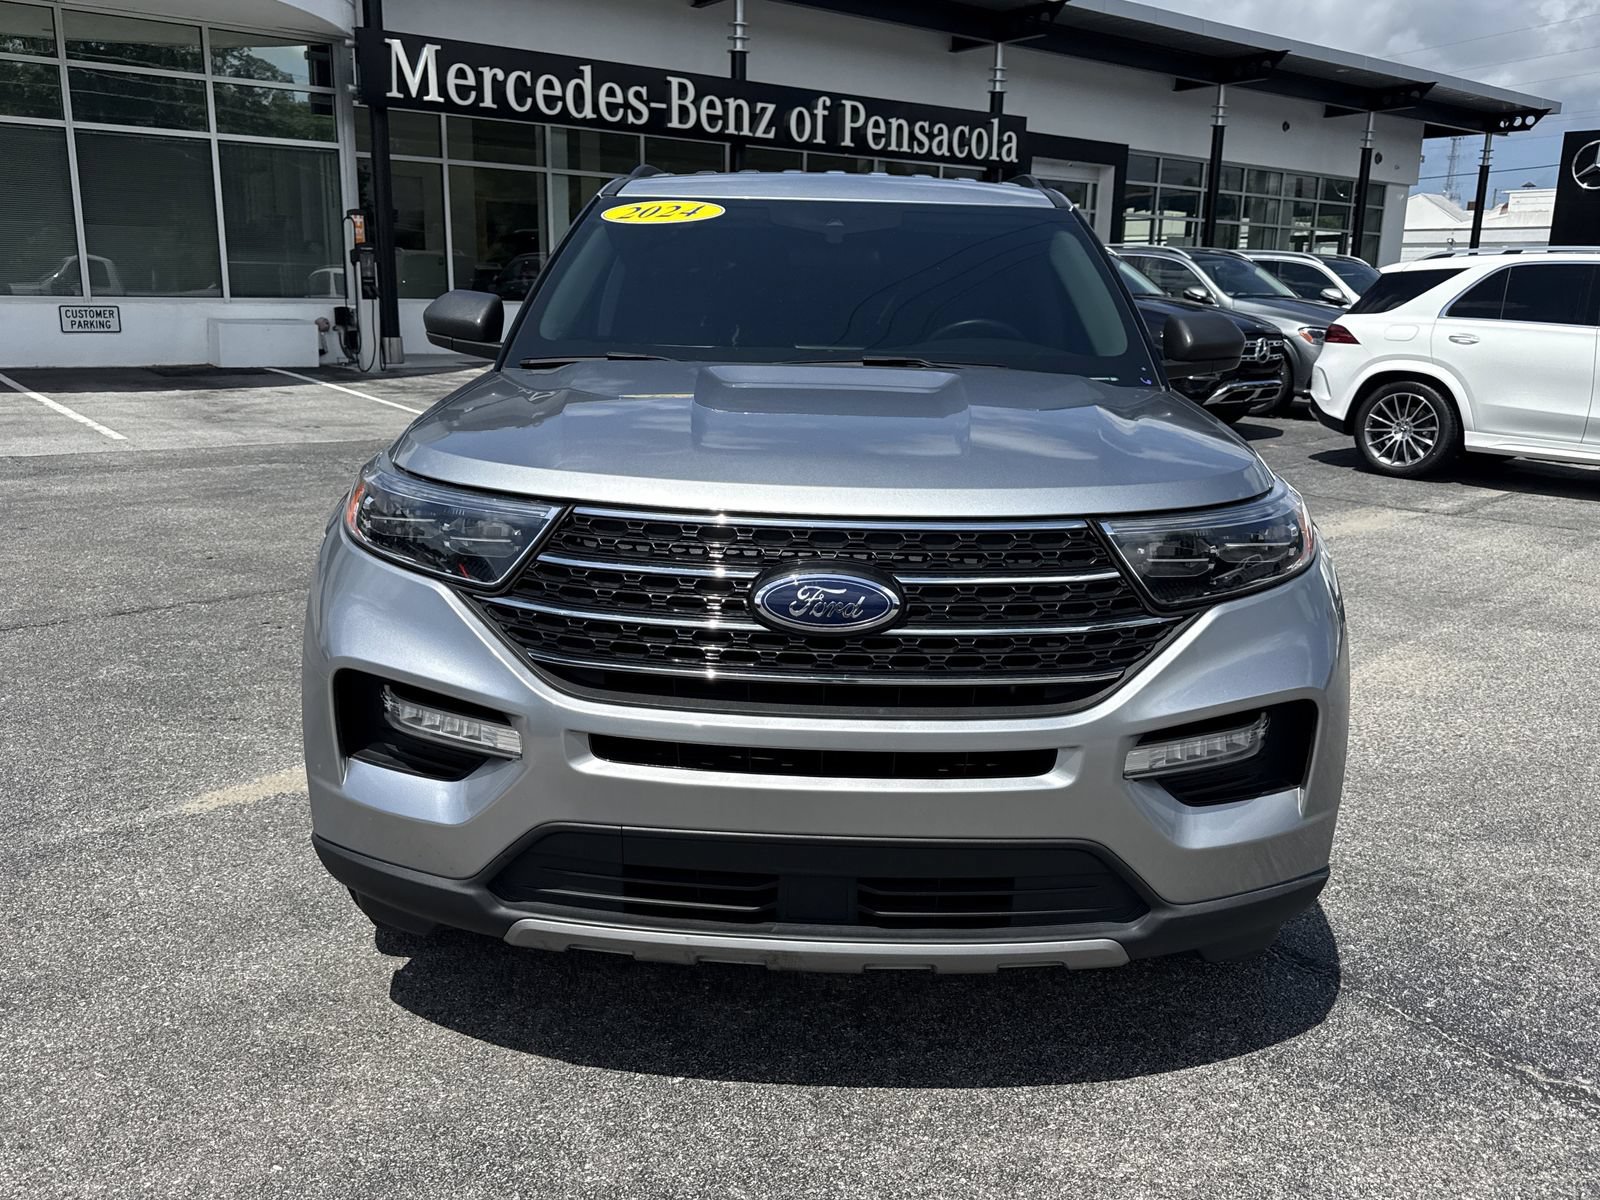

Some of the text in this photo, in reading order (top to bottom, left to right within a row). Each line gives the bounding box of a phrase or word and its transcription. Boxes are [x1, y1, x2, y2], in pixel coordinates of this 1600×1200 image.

[384, 38, 1019, 163] Mercedes-Benz of Pensacola
[616, 205, 706, 219] 2024
[65, 309, 115, 319] CUSTOMER
[70, 320, 111, 329] PARKING
[789, 585, 866, 618] Ford
